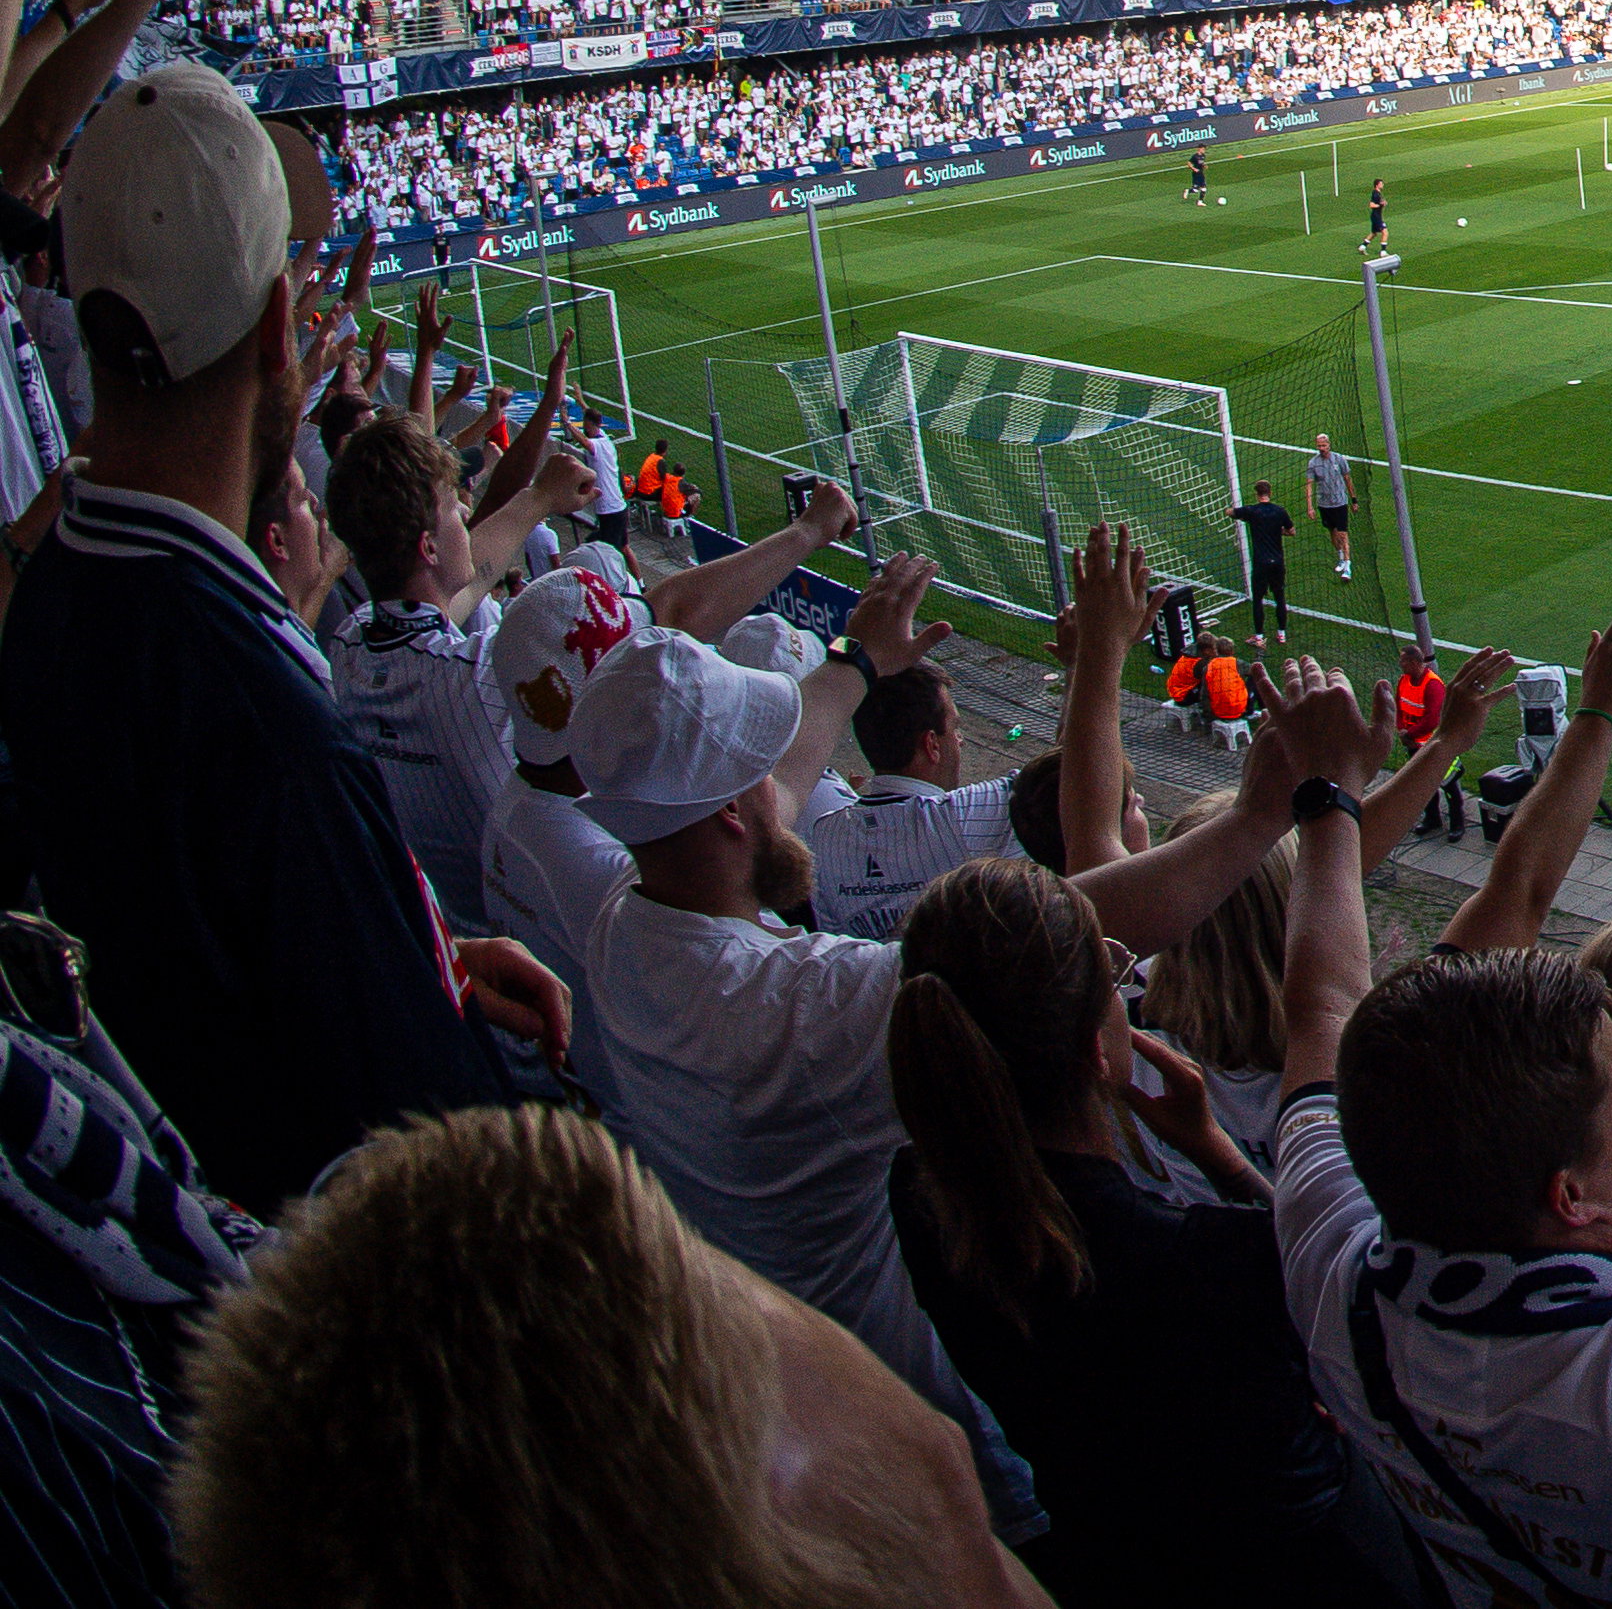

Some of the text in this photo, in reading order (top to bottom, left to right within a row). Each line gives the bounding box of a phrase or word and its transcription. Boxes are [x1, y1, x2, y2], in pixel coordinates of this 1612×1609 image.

[587, 45, 622, 58] KSDH
[1268, 108, 1320, 132] Sydbank
[1163, 125, 1218, 149] Sydbank
[1047, 141, 1106, 167] Sydbank
[923, 159, 986, 186] Sydbank
[649, 202, 721, 229] Sydbank
[838, 880, 925, 897] Andelskassen
